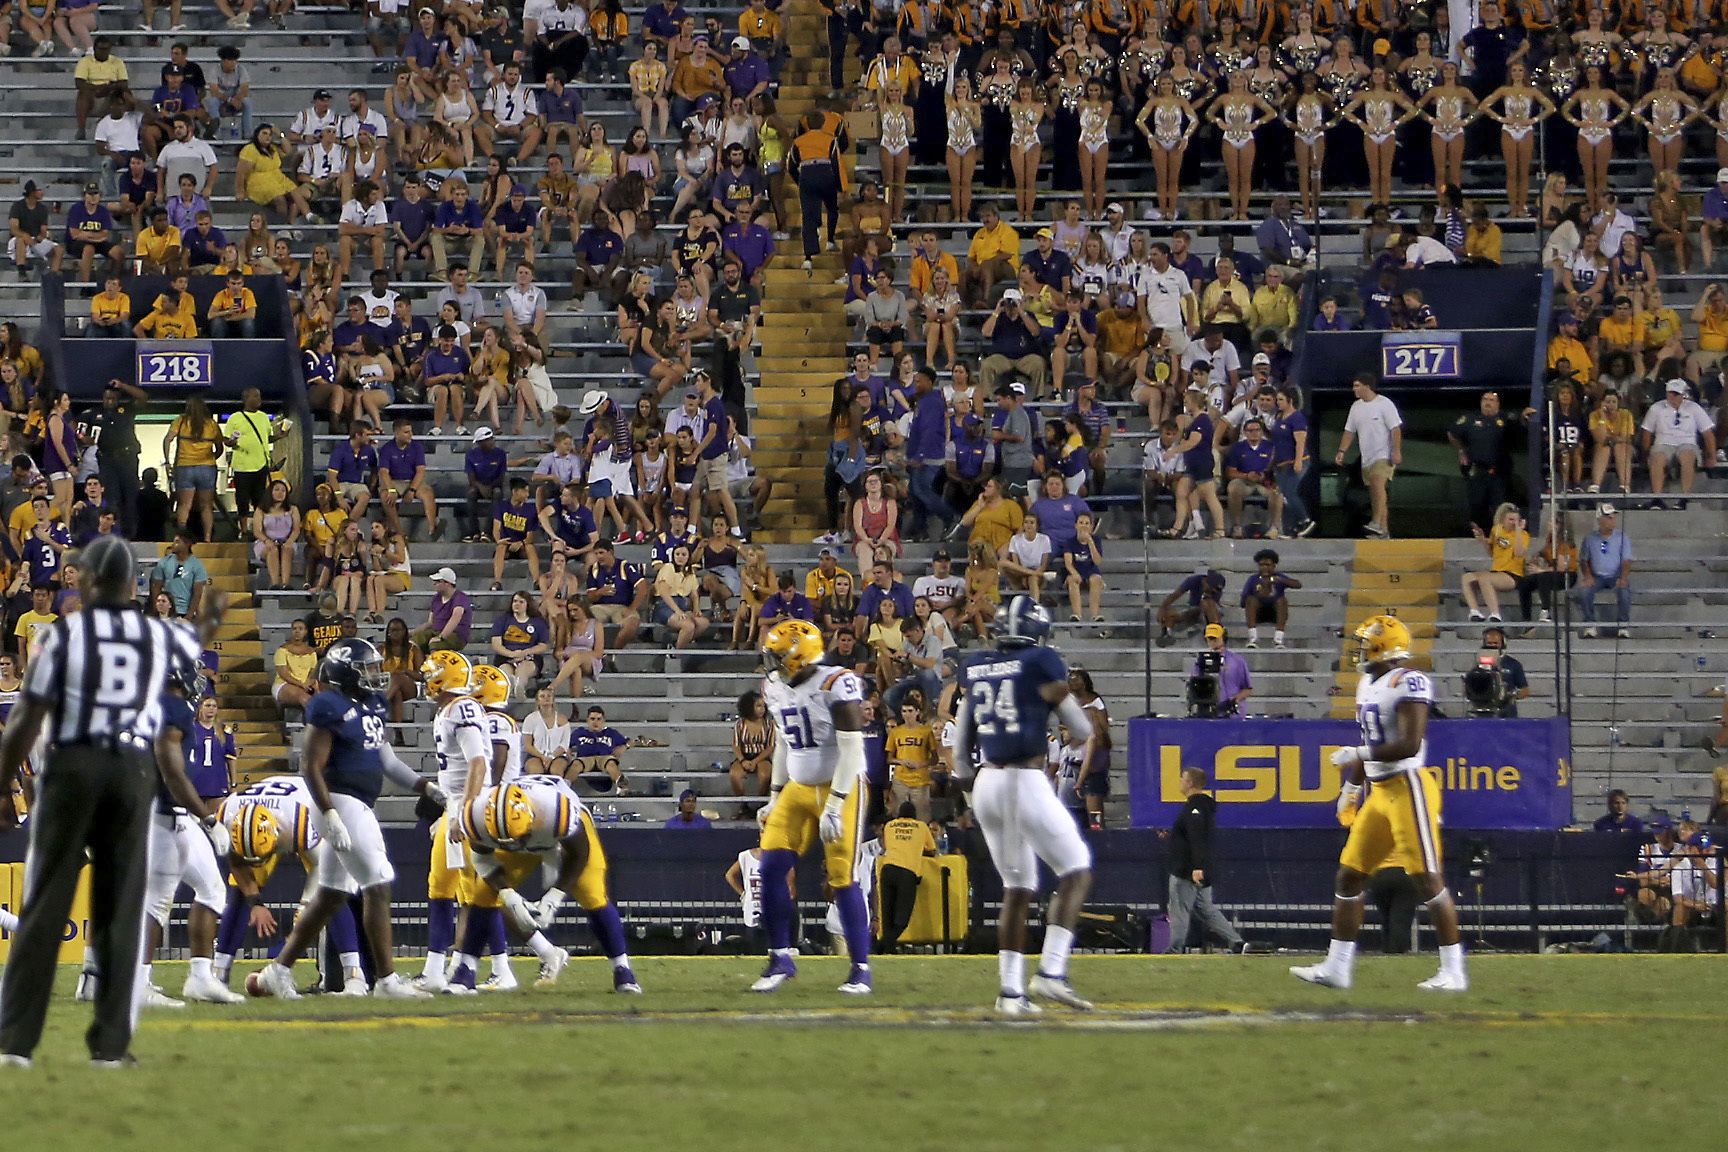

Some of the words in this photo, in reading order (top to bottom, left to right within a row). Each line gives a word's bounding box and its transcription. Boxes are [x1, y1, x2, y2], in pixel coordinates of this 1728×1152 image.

[79, 220, 101, 230] LSU
[150, 357, 200, 382] 218
[308, 361, 314, 370] 7
[1395, 349, 1445, 374] 217
[1559, 426, 1577, 443] 18
[43, 551, 55, 567] 3
[1389, 575, 1400, 583] 13
[926, 584, 957, 597] LSU
[1385, 608, 1398, 616] 12
[314, 626, 342, 638] GEAUX
[97, 641, 138, 706] B
[459, 703, 475, 719] 15
[973, 679, 1019, 734] 24
[782, 706, 819, 750] 51
[898, 737, 923, 747] LSU
[203, 738, 213, 766] 1
[238, 748, 244, 756] 7
[243, 775, 250, 783] 6
[1161, 745, 1342, 803] LSU
[1427, 757, 1521, 791] nline
